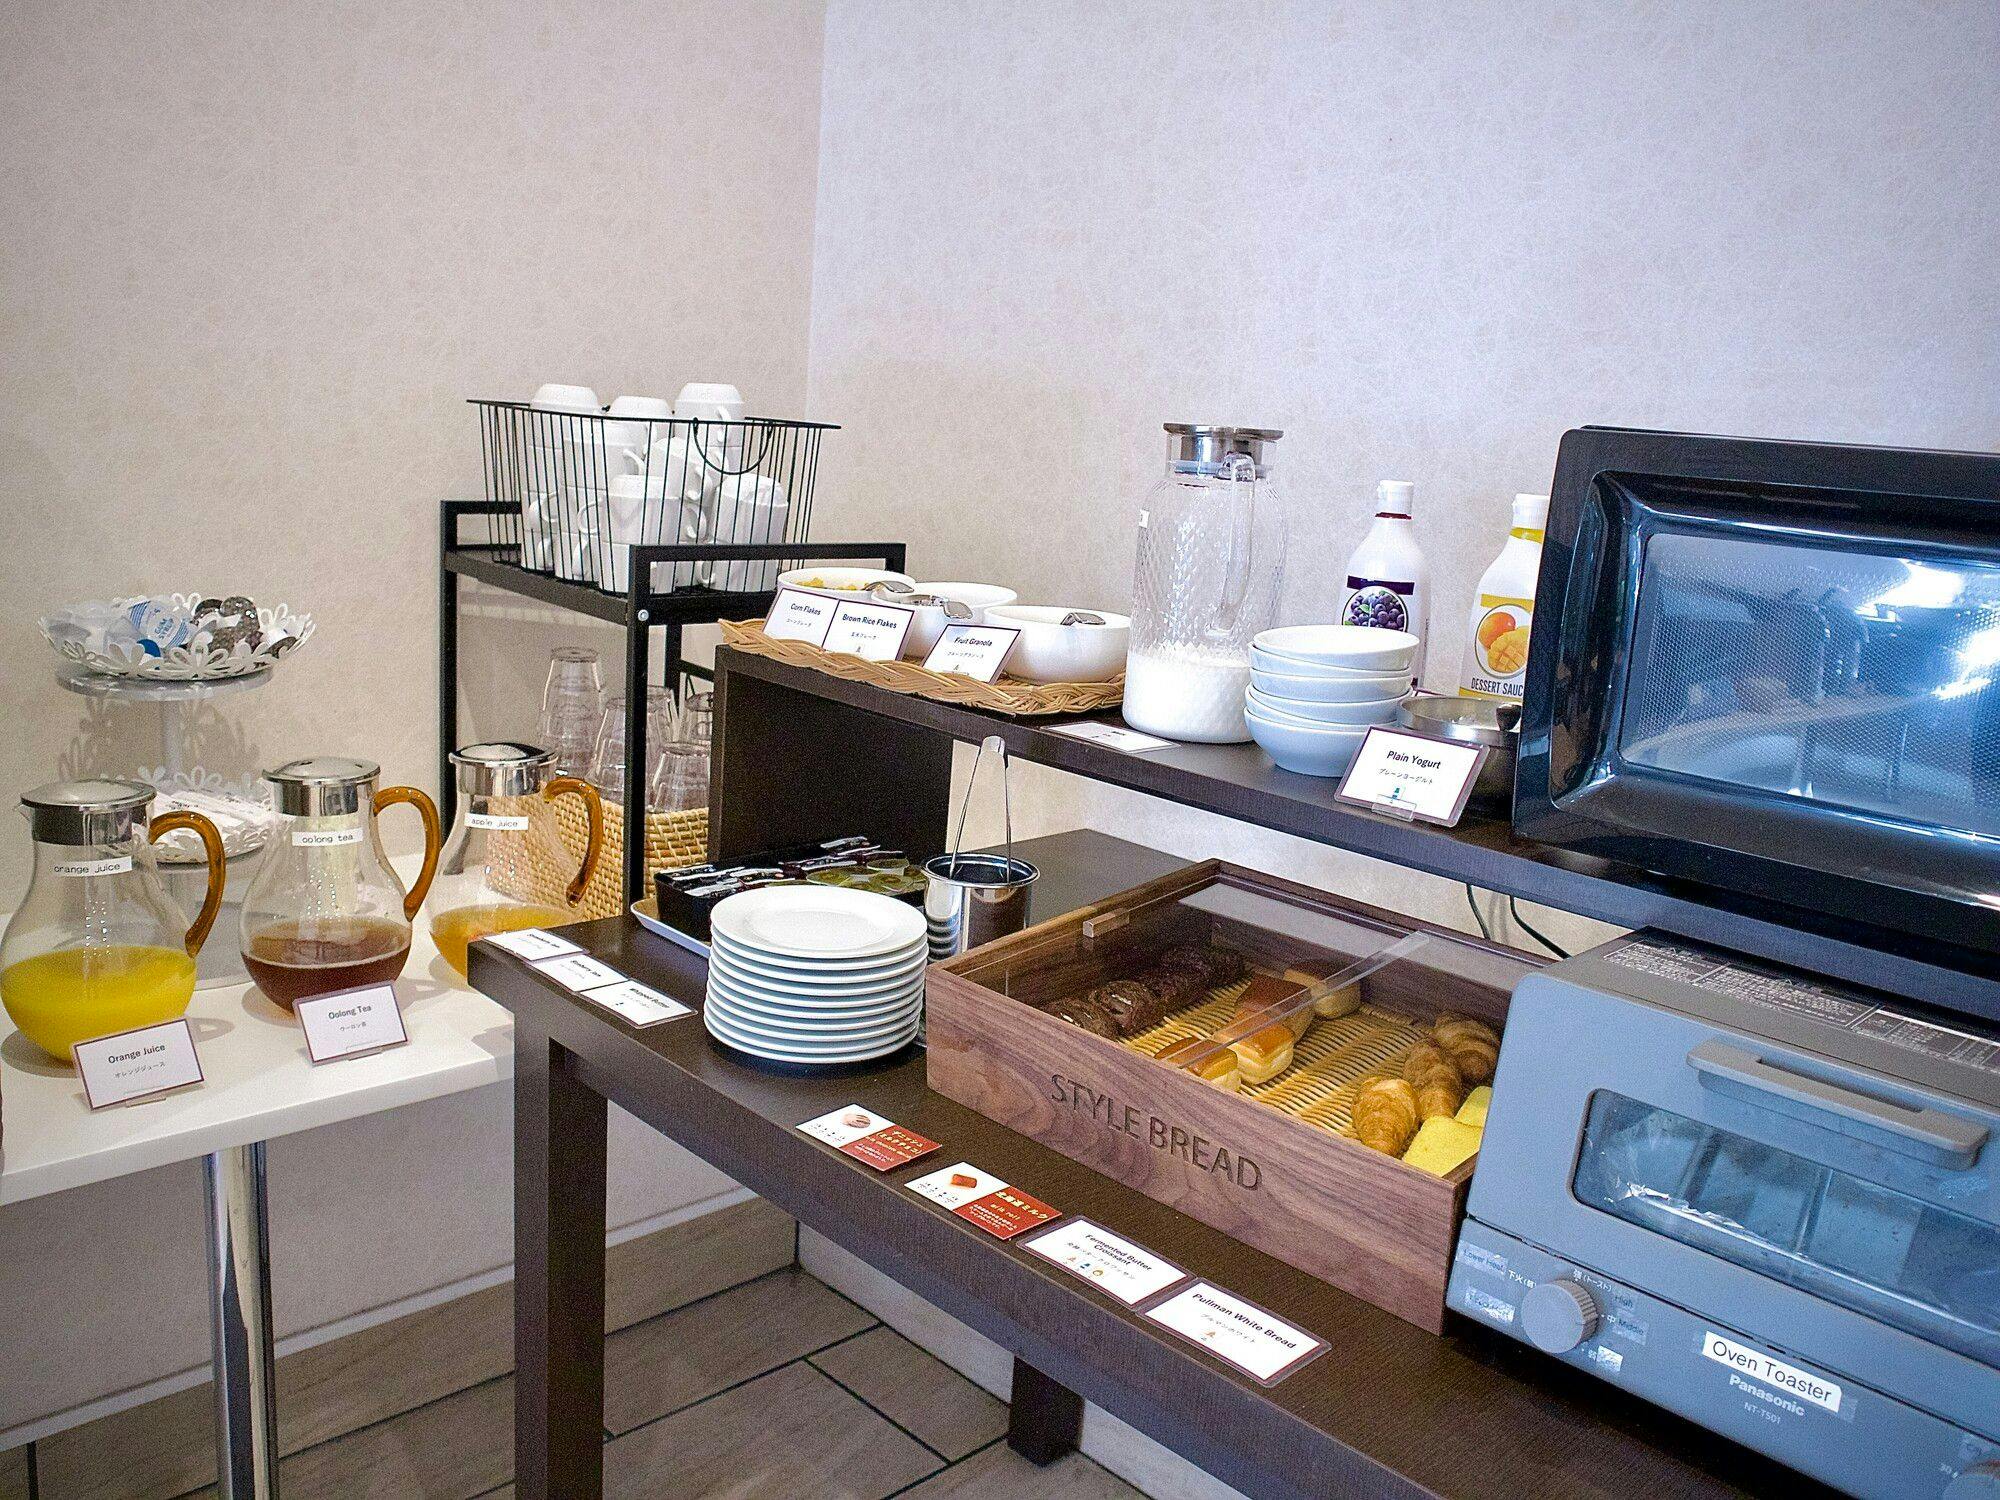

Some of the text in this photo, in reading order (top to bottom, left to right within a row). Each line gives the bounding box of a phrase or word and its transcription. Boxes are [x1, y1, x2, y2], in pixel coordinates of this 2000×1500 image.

[790, 602, 822, 616] Corn Flakes
[842, 613, 898, 630] Brown Rice Flakes
[954, 636, 993, 647] Fruit Granola
[1470, 677, 1524, 697] DESSERT SAUC
[1386, 750, 1441, 770] Plain Yogurt
[471, 818, 518, 828] apple juice
[302, 833, 354, 844] oolong tea
[54, 862, 121, 874] orange juice
[328, 1004, 372, 1020] Oolong Tea
[108, 1043, 166, 1064] Orange Juice
[115, 1061, 166, 1079] オレンジジュース
[1051, 1073, 1263, 1192] STYLE BREAD
[1085, 1233, 1153, 1272] Fermented Butter
[1093, 1243, 1132, 1267] Croissant
[1192, 1292, 1298, 1350] Pullman White Bread
[1606, 1313, 1617, 1324] 中
[1712, 1340, 1833, 1402] Oven Toaster
[1729, 1373, 1806, 1417] Panasonic
[1744, 1401, 1782, 1425] NT-T501
